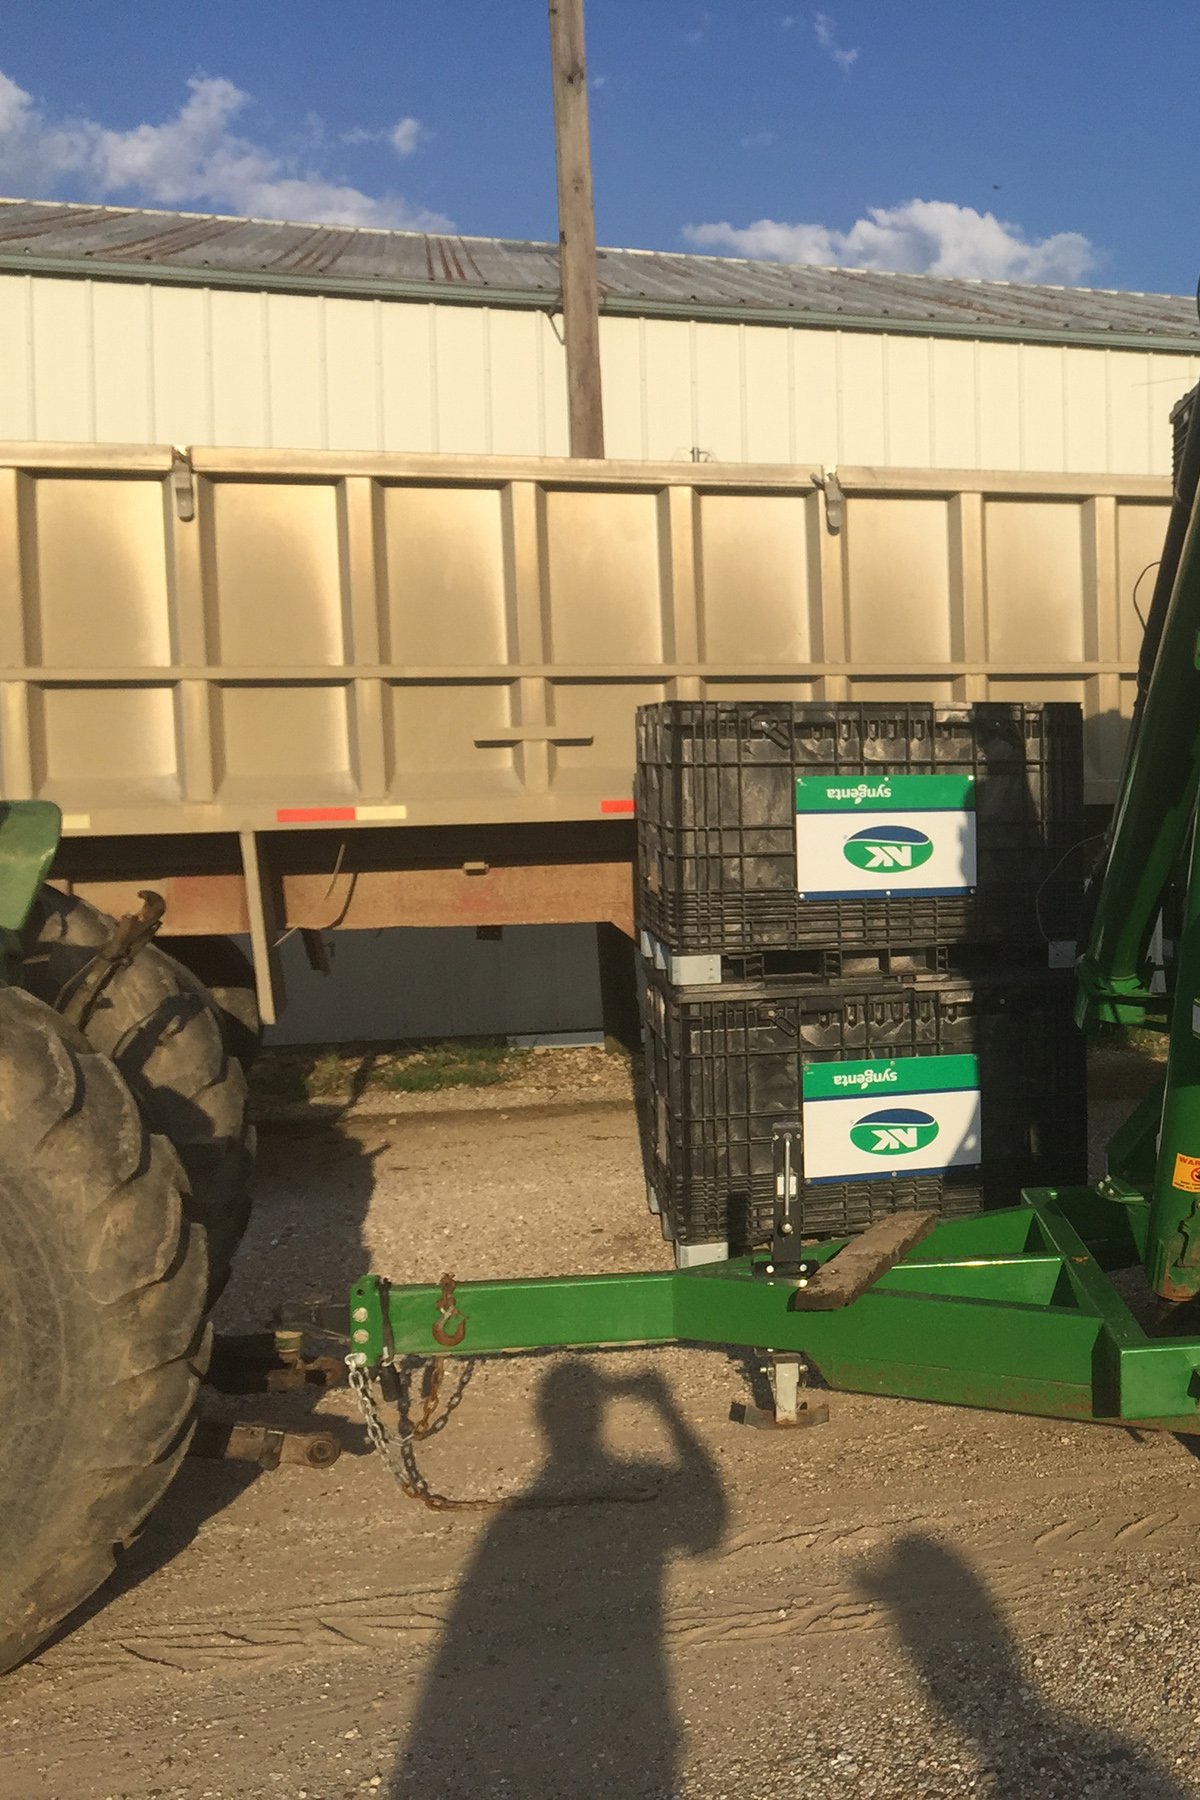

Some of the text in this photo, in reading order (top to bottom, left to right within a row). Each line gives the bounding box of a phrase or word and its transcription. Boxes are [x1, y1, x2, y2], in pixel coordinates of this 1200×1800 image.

[826, 783, 892, 803] syngenta
[863, 845, 913, 868] NK
[833, 1068, 898, 1088] syngenta
[870, 1127, 918, 1151] NK
